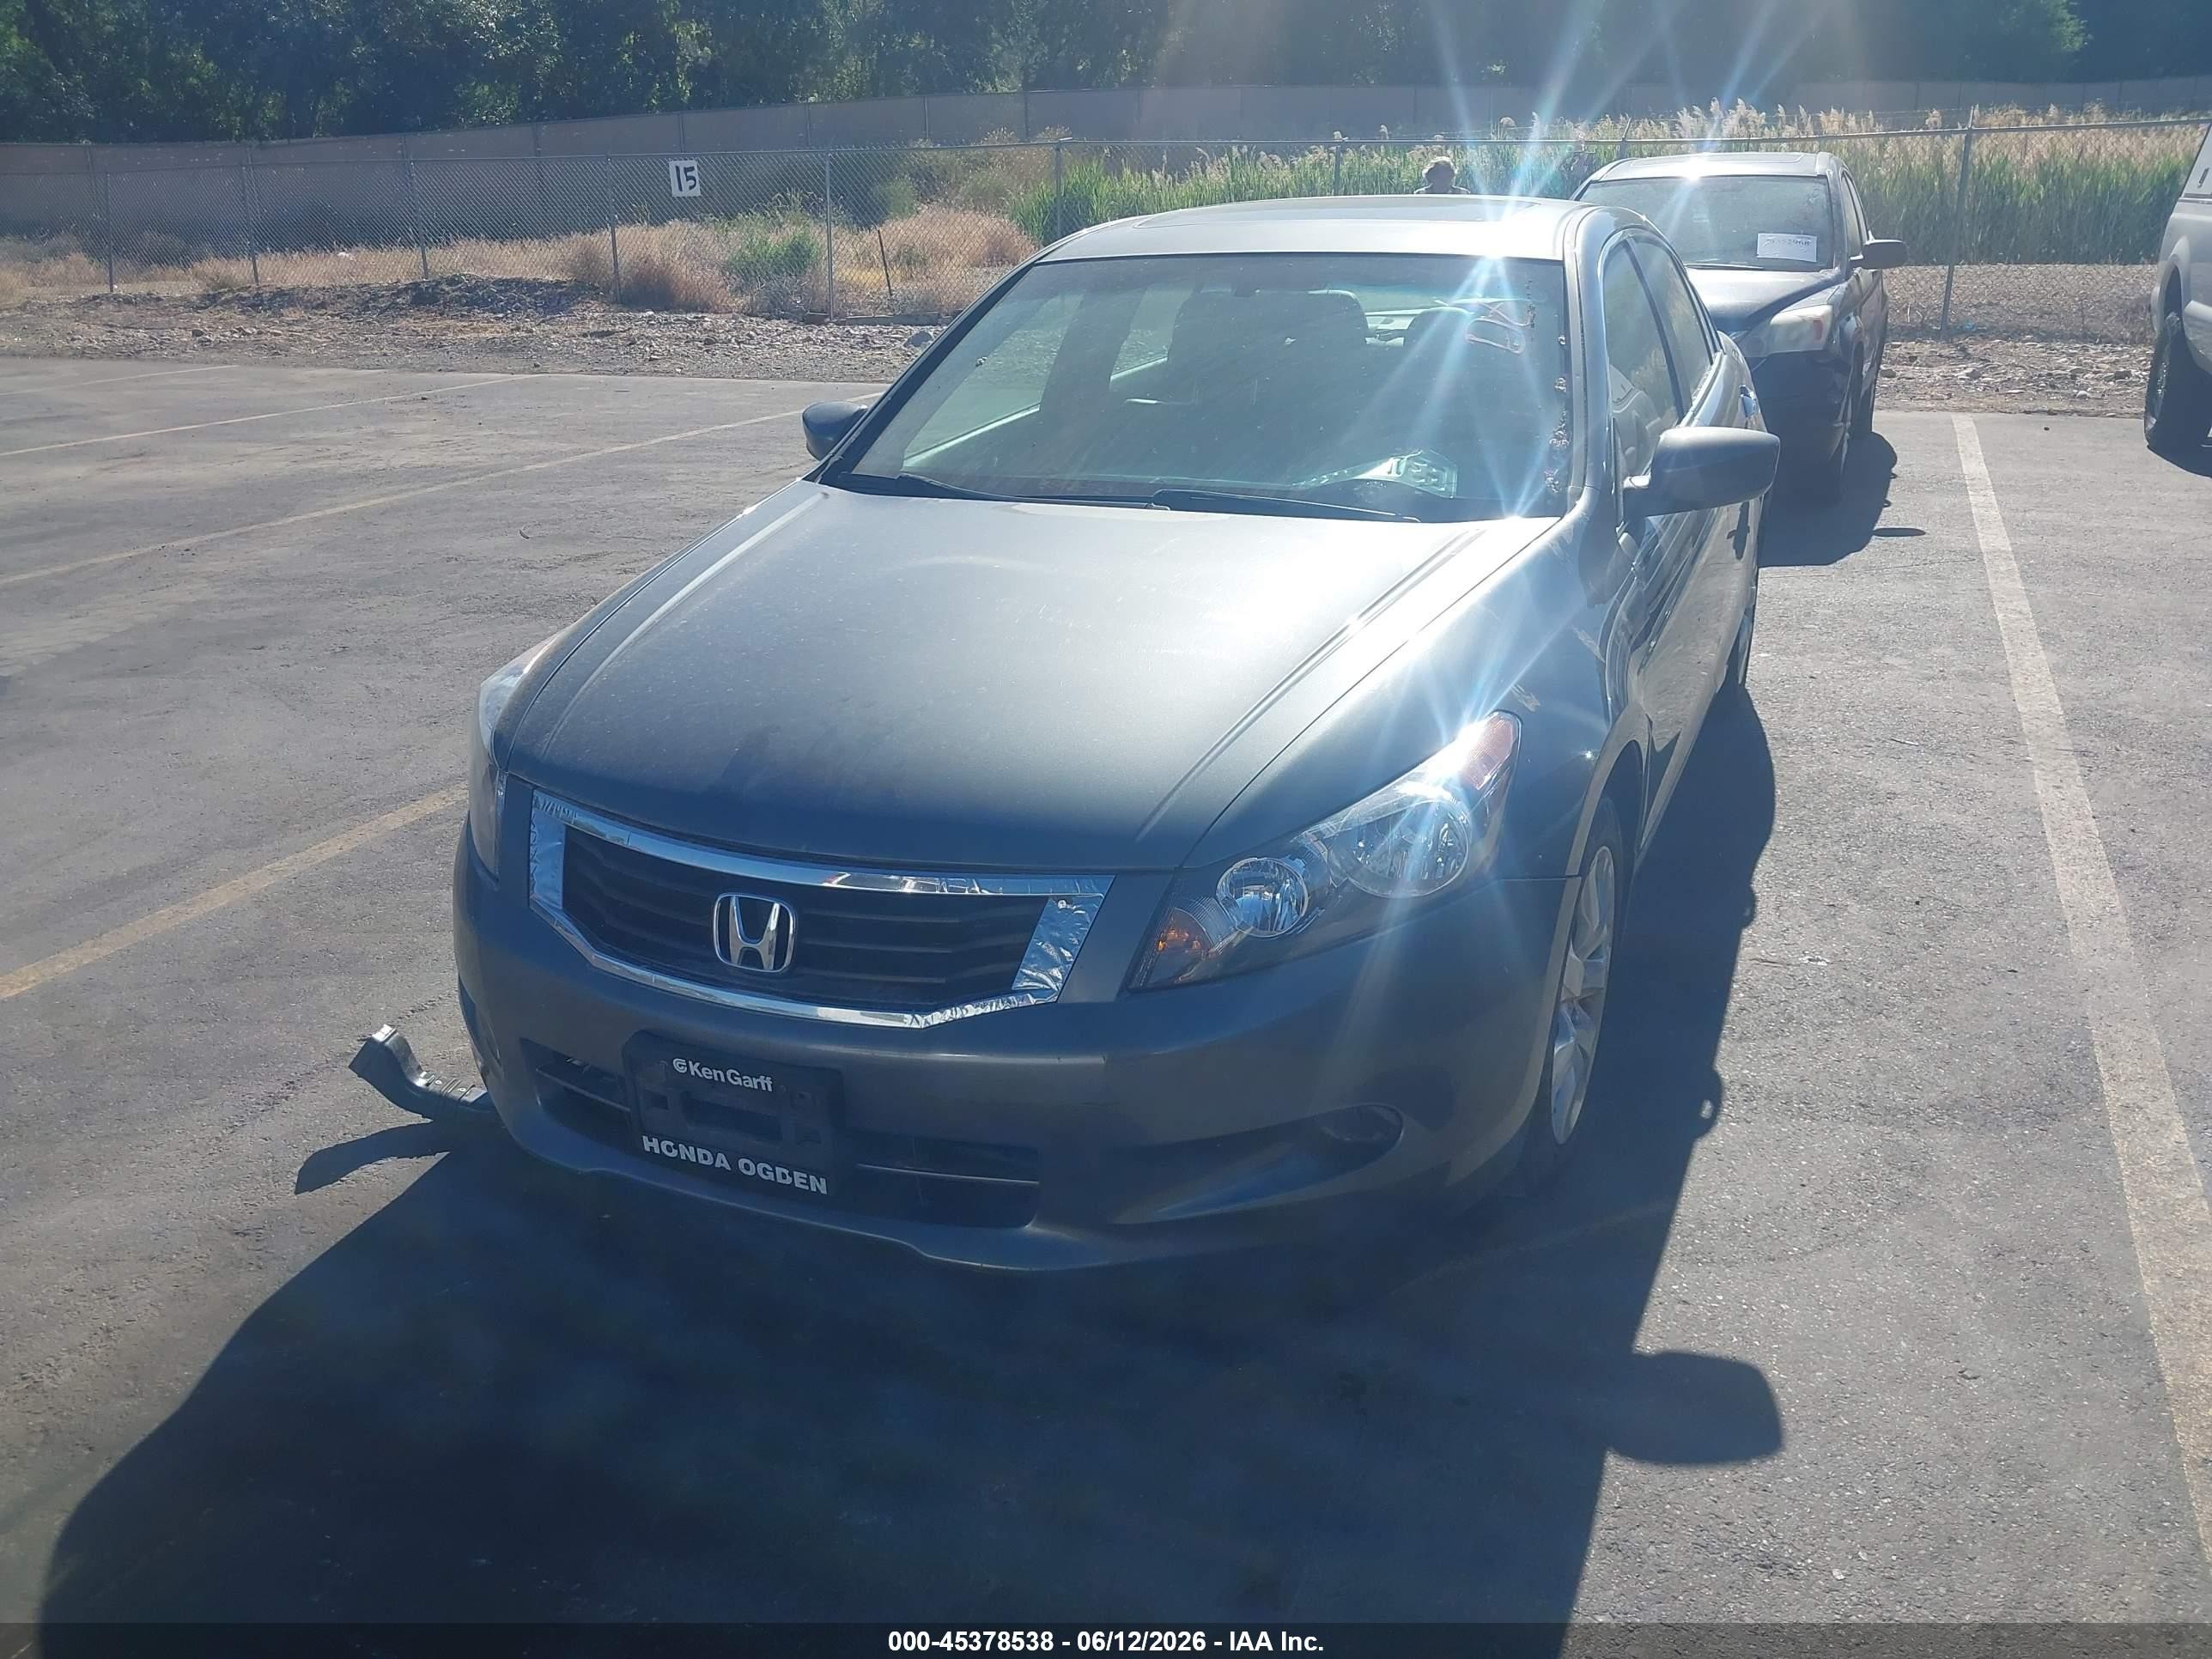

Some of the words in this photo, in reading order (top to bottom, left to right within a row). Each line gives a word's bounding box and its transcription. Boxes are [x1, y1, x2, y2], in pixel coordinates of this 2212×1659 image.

[675, 166, 697, 192] 15
[688, 1060, 726, 1083] Ken
[726, 1068, 773, 1092] Garff
[642, 1134, 732, 1171] HONDA
[737, 1158, 828, 1195] OGDEN
